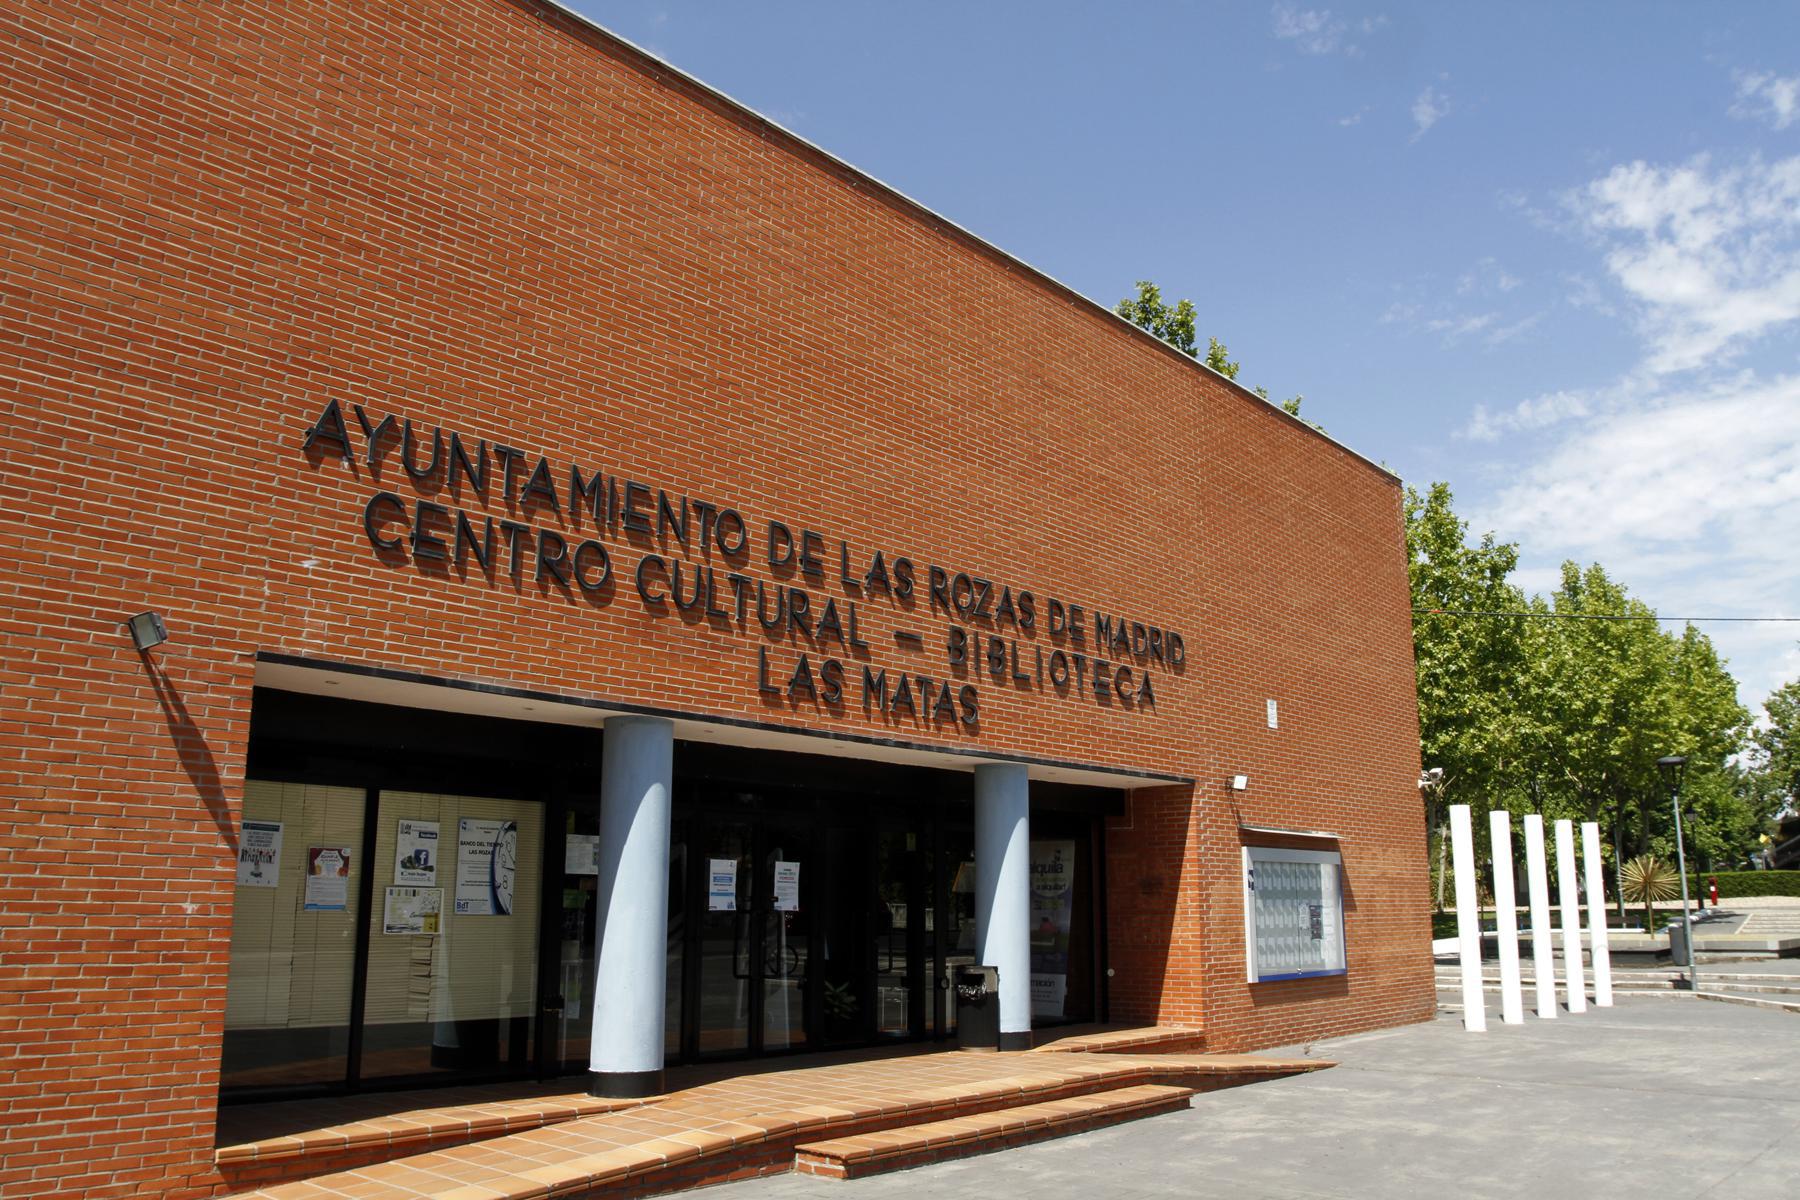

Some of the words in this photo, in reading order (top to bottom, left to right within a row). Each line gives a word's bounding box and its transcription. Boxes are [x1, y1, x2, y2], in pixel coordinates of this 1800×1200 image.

[302, 399, 747, 556] AYUNTAMIENTO
[768, 519, 824, 577] DE
[841, 540, 914, 600] LAS
[929, 564, 1037, 629] ROZAS
[1048, 598, 1085, 642] DE
[1094, 610, 1186, 665] MADRID
[363, 492, 612, 590] CENTRO
[635, 554, 869, 649] CULTURAL
[948, 625, 1156, 706] BIBLIOTECA
[758, 645, 844, 703] LAS
[862, 664, 979, 726] MATAS
